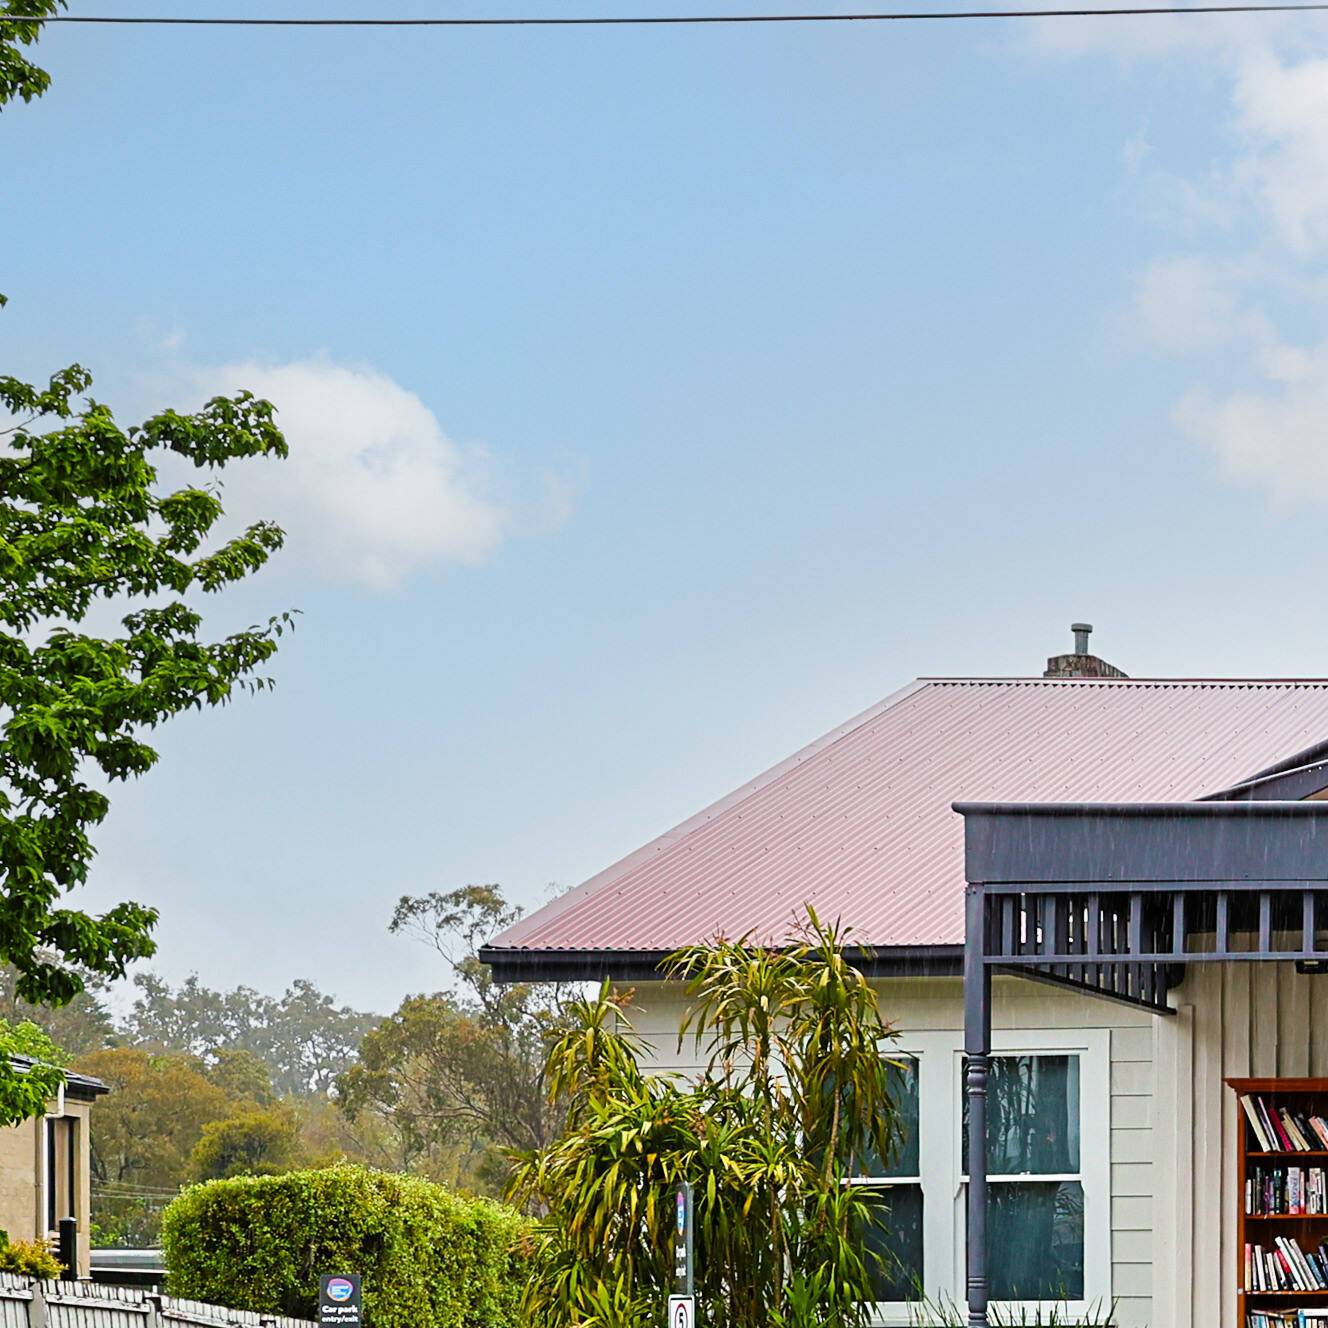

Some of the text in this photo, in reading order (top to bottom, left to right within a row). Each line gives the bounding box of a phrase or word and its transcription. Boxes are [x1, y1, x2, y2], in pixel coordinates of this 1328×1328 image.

[322, 1304, 358, 1315] Car park
[321, 1315, 359, 1324] entry/exit
